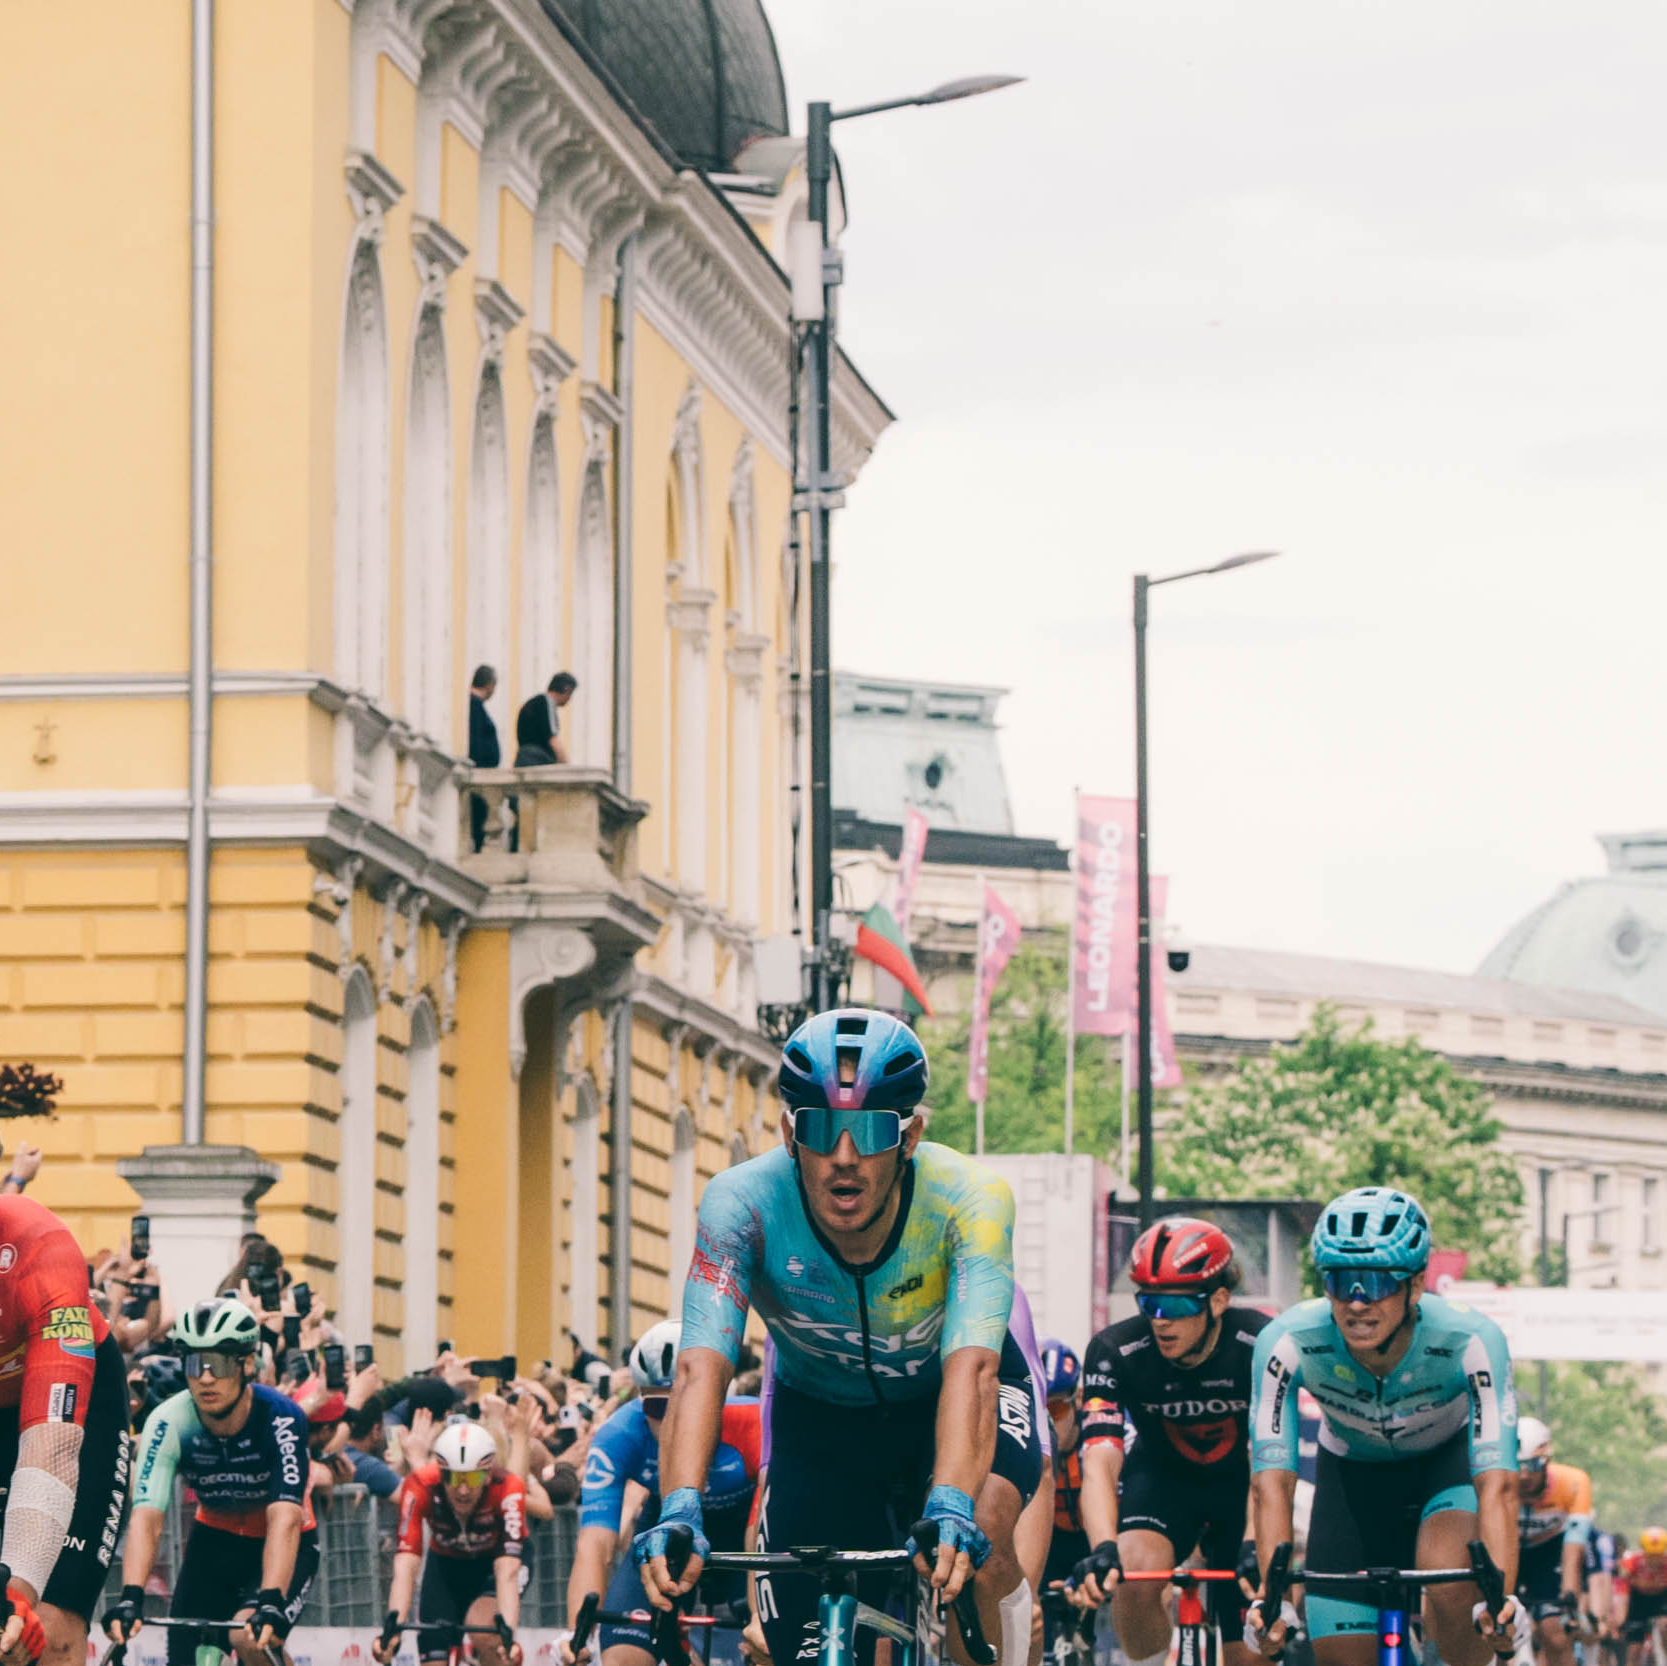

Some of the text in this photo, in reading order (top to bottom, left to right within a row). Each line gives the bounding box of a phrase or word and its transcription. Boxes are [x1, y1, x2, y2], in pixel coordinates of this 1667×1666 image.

[1087, 820, 1124, 1012] LEONARDO
[1119, 1335, 1151, 1357] BMC
[1085, 1374, 1116, 1389] MSC
[1142, 1400, 1249, 1418] TUDOR
[271, 1415, 301, 1486] Adecco
[97, 1490, 125, 1568] REMA
[1180, 1627, 1195, 1666] BMC
